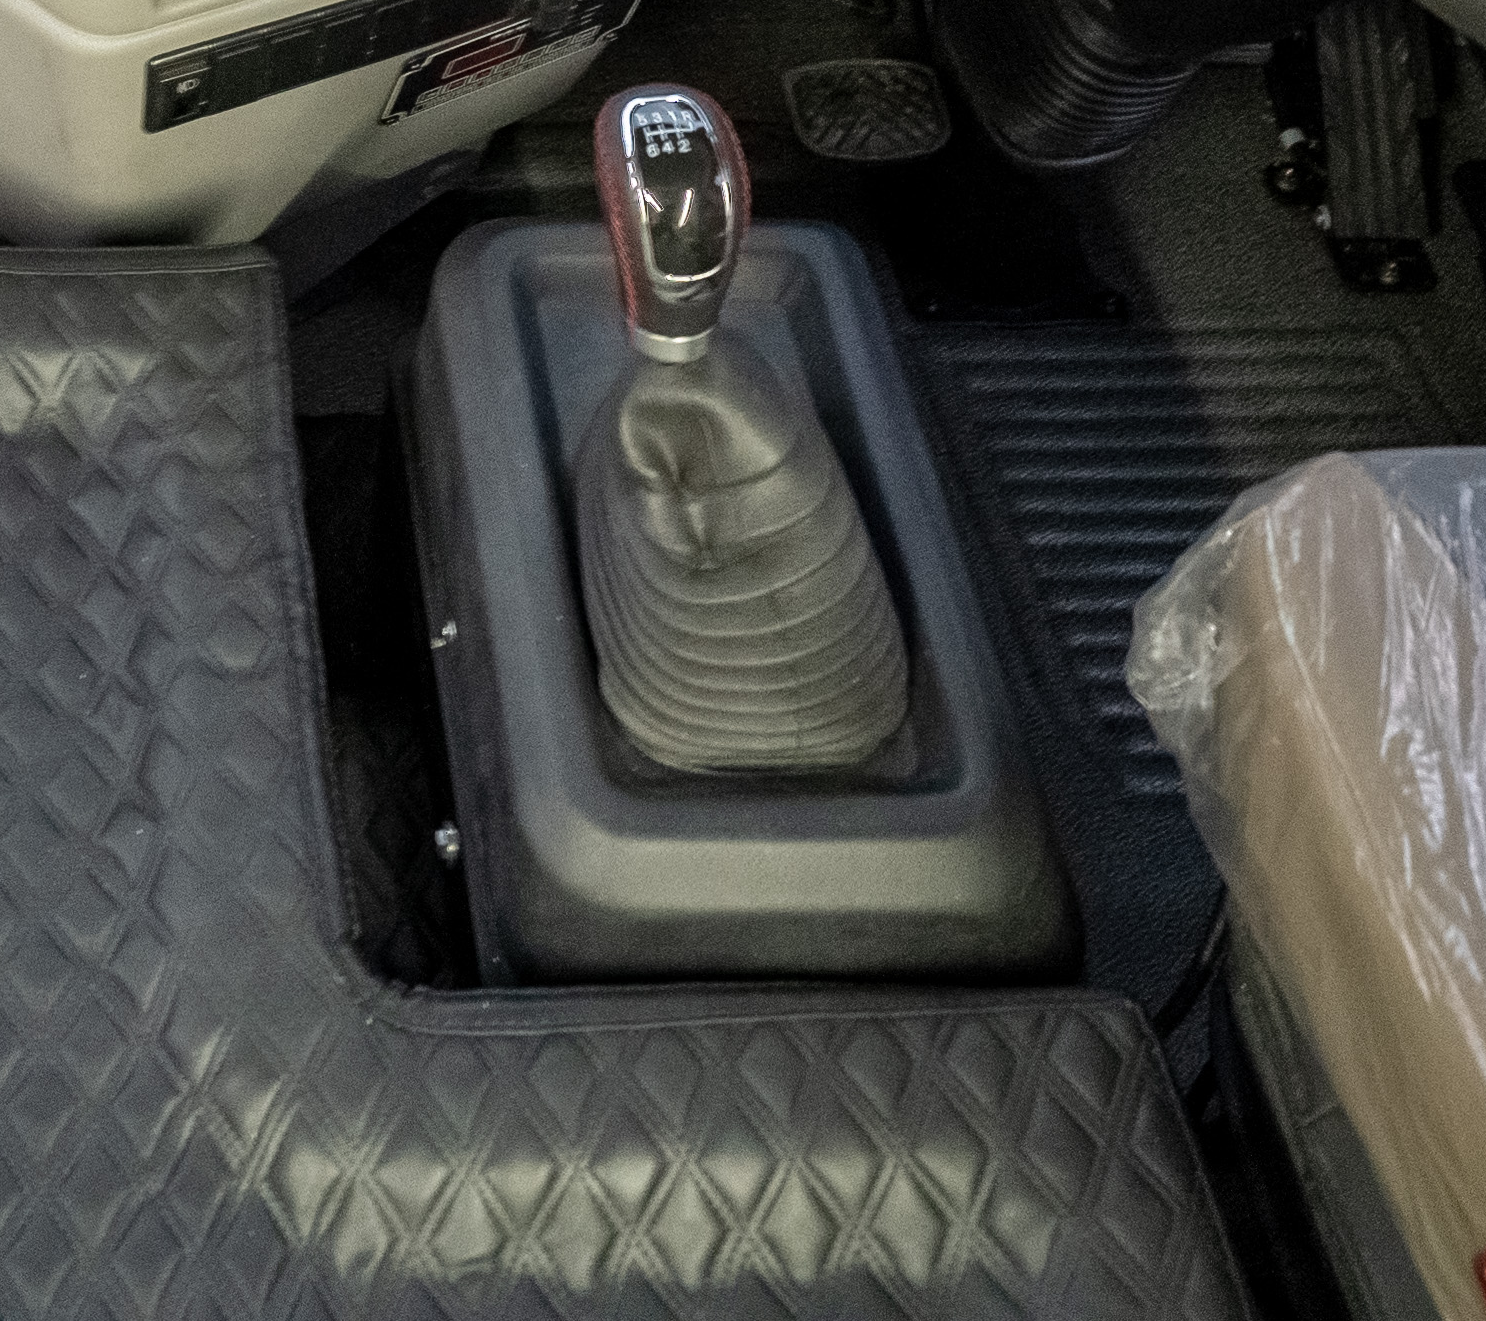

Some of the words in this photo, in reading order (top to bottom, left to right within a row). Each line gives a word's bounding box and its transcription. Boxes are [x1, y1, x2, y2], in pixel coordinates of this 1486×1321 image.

[651, 112, 663, 124] 3
[662, 139, 675, 155] 4
[677, 139, 692, 154] 2
